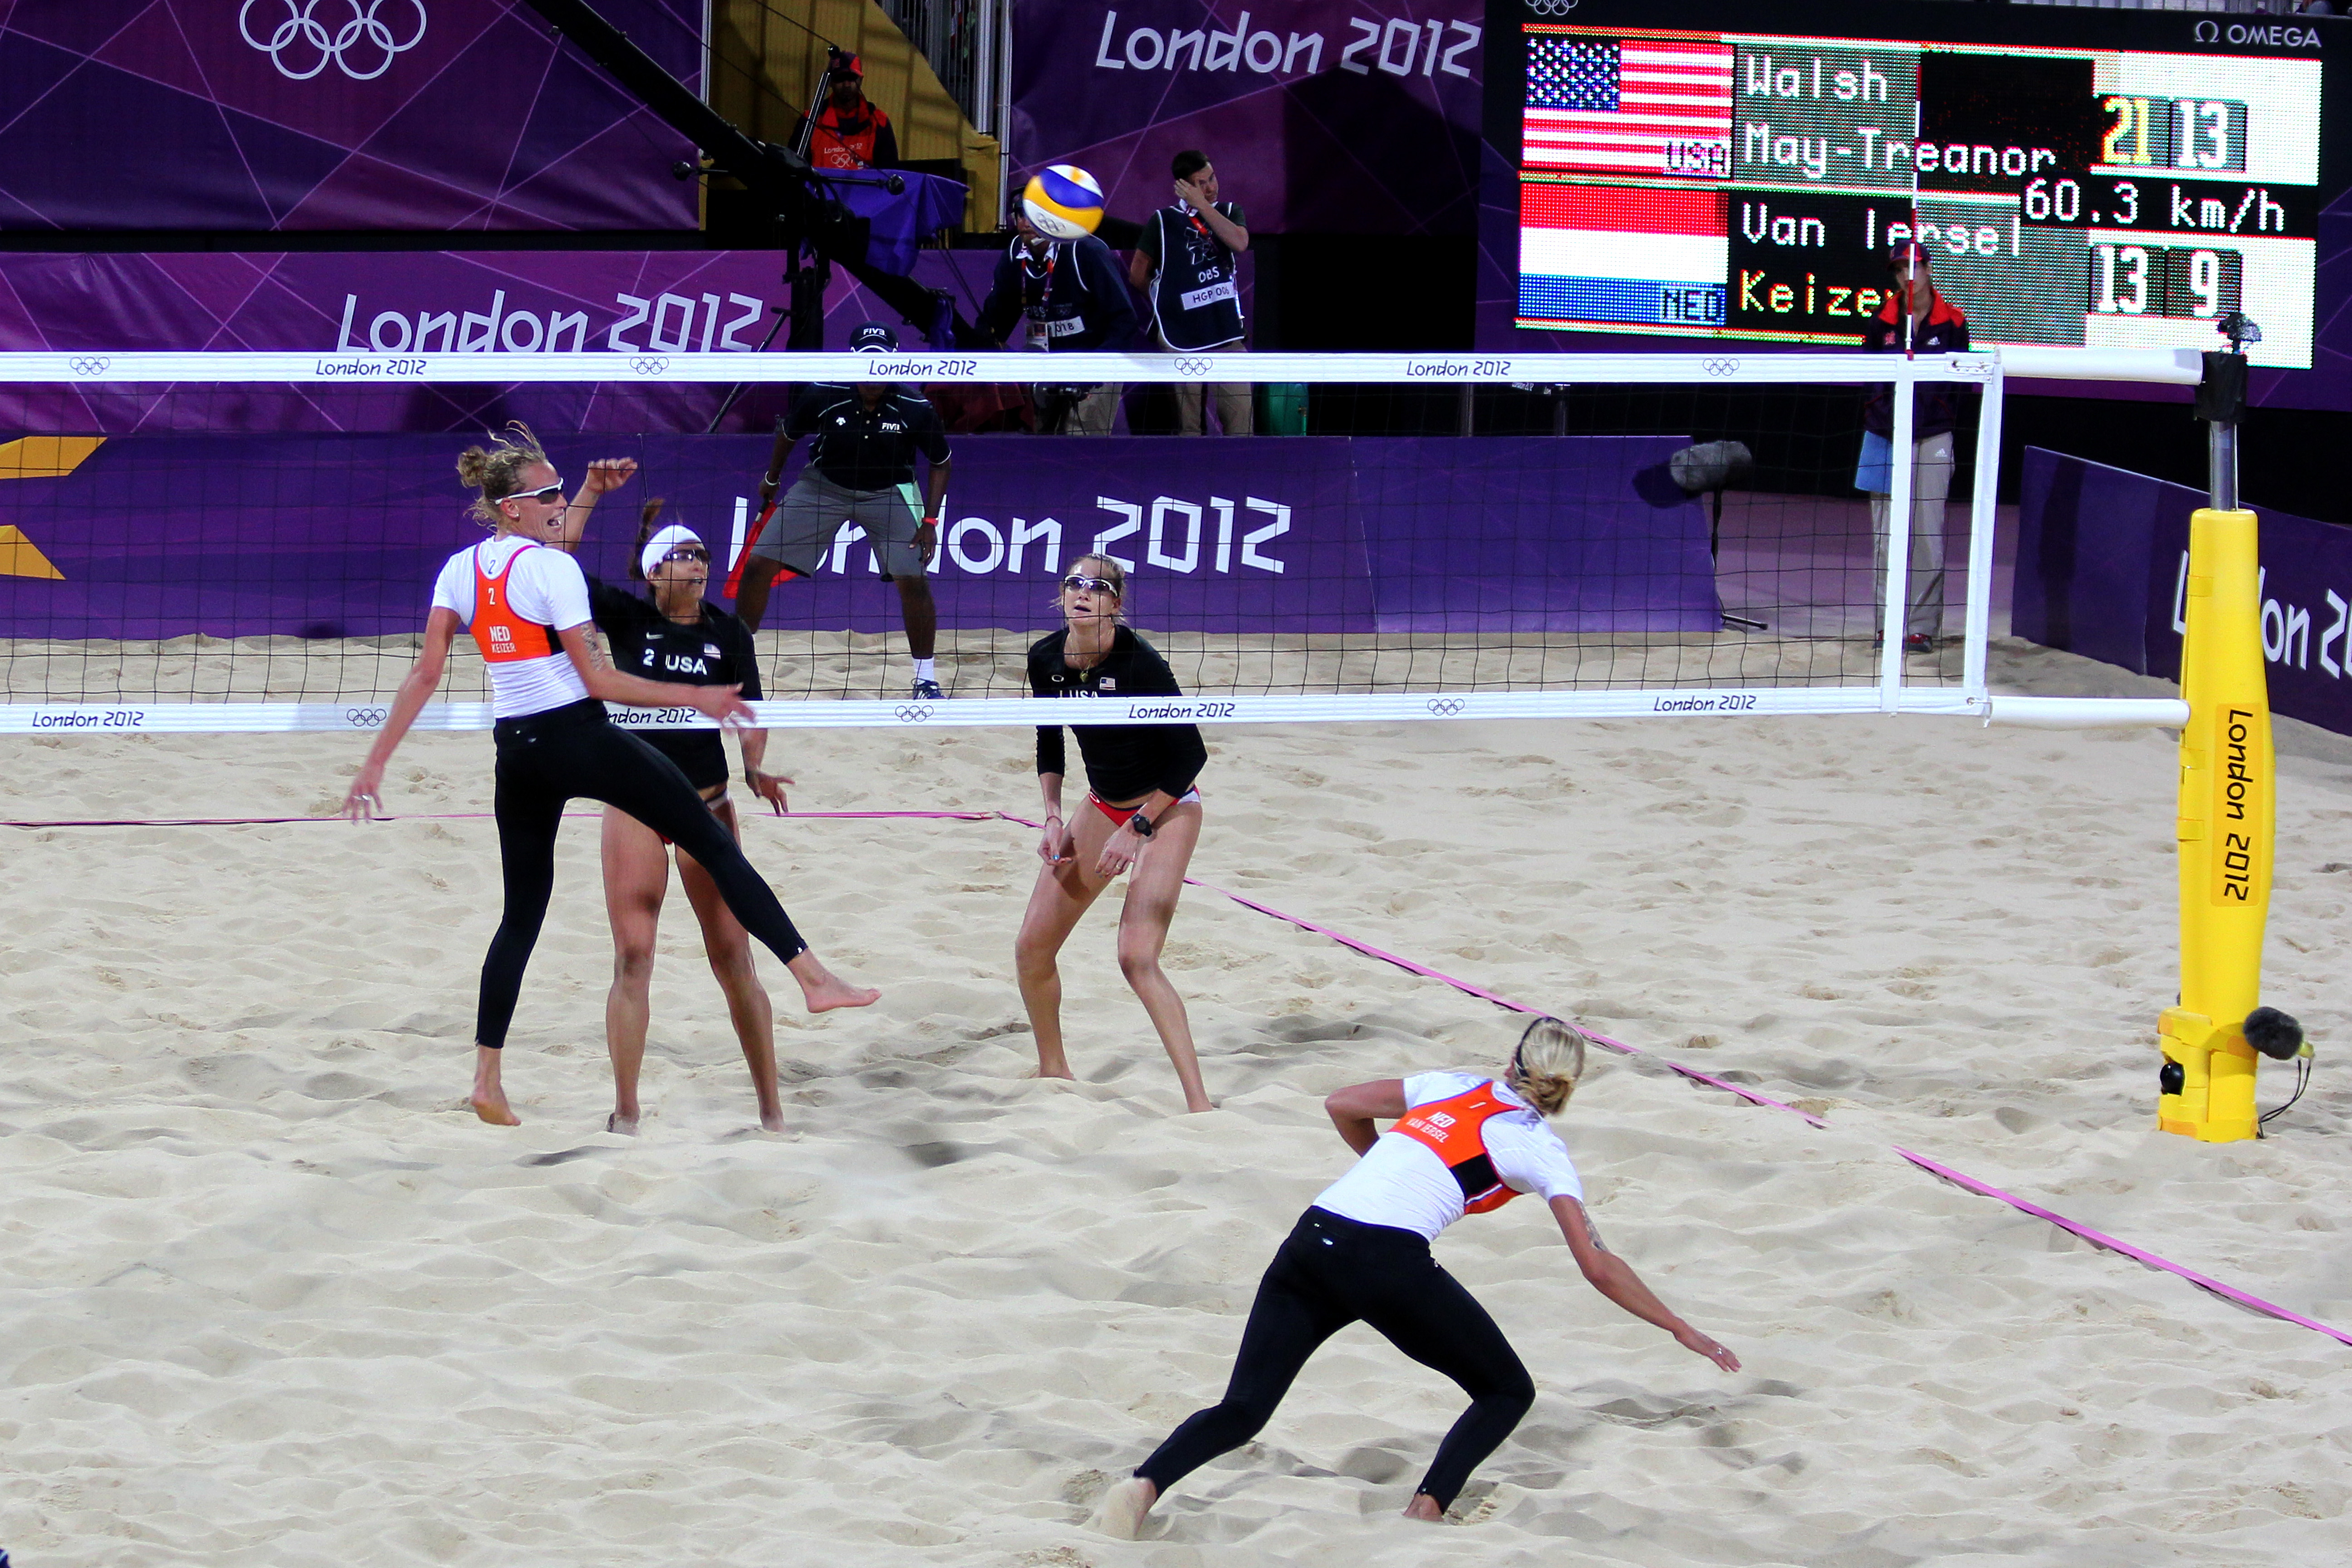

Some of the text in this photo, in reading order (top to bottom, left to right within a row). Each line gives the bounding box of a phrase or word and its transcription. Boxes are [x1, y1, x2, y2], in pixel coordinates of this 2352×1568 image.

[1095, 10, 1482, 78] London 2012
[2228, 24, 2322, 48] OMEGA
[1747, 55, 1887, 102] Walsh
[2103, 96, 2228, 168] 21 13
[1667, 141, 1725, 172] USA
[1745, 122, 2057, 179] May-Treanor
[2024, 177, 2284, 233] 60.3 km/h
[1742, 202, 1825, 247] Van
[1198, 266, 1220, 283] OBS
[2097, 245, 2220, 318] 13 9
[1192, 290, 1213, 303] HGP
[1664, 289, 1722, 321] NED
[1740, 269, 1895, 318] Keize
[336, 289, 764, 353] London 2012
[315, 359, 426, 375] London 2012
[868, 359, 977, 376] London 2012
[1406, 360, 1511, 376] London 2012
[1093, 495, 1292, 574] 2012
[488, 559, 496, 574] 2
[488, 587, 496, 605] 2
[489, 625, 511, 642] NED
[491, 642, 516, 654] KEIZER
[643, 648, 708, 676] 2 USA
[1128, 703, 1235, 719] London 2012
[1653, 695, 1756, 711] London 2012
[32, 711, 144, 727] London 2012
[608, 708, 696, 724] ndon 2012
[2224, 709, 2254, 902] London 2012
[1406, 1117, 1449, 1143] VAN IERSEL
[1425, 1111, 1457, 1128] NED
